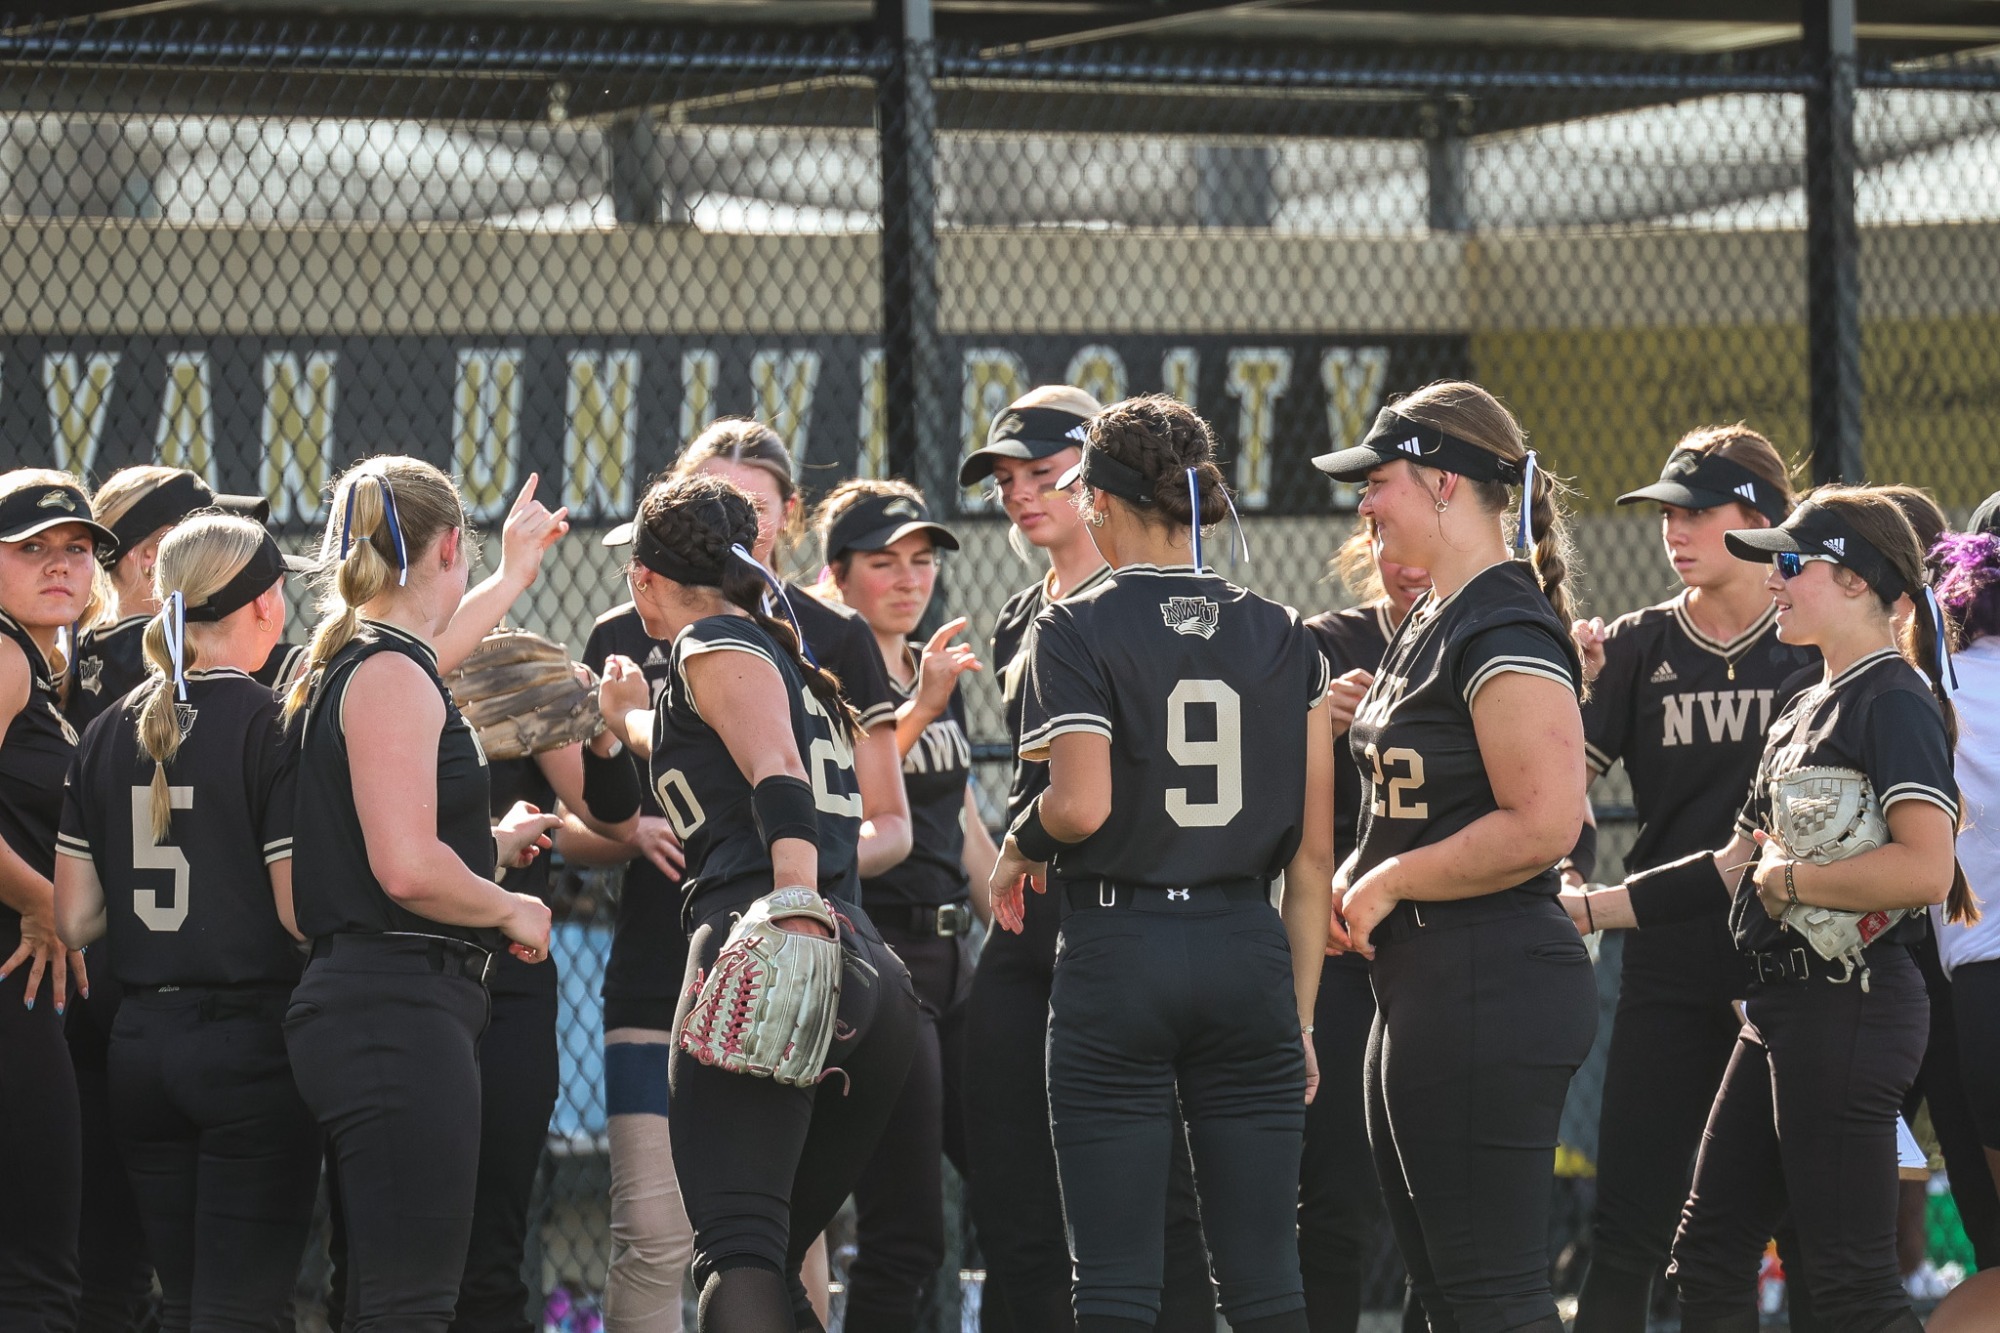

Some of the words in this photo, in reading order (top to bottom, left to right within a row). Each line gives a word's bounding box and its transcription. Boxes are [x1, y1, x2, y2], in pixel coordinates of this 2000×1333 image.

[0, 350, 338, 524] YAN
[1162, 597, 1218, 628] NWU
[1165, 679, 1243, 828] 9
[1364, 742, 1429, 819] 22
[131, 785, 195, 932] 5
